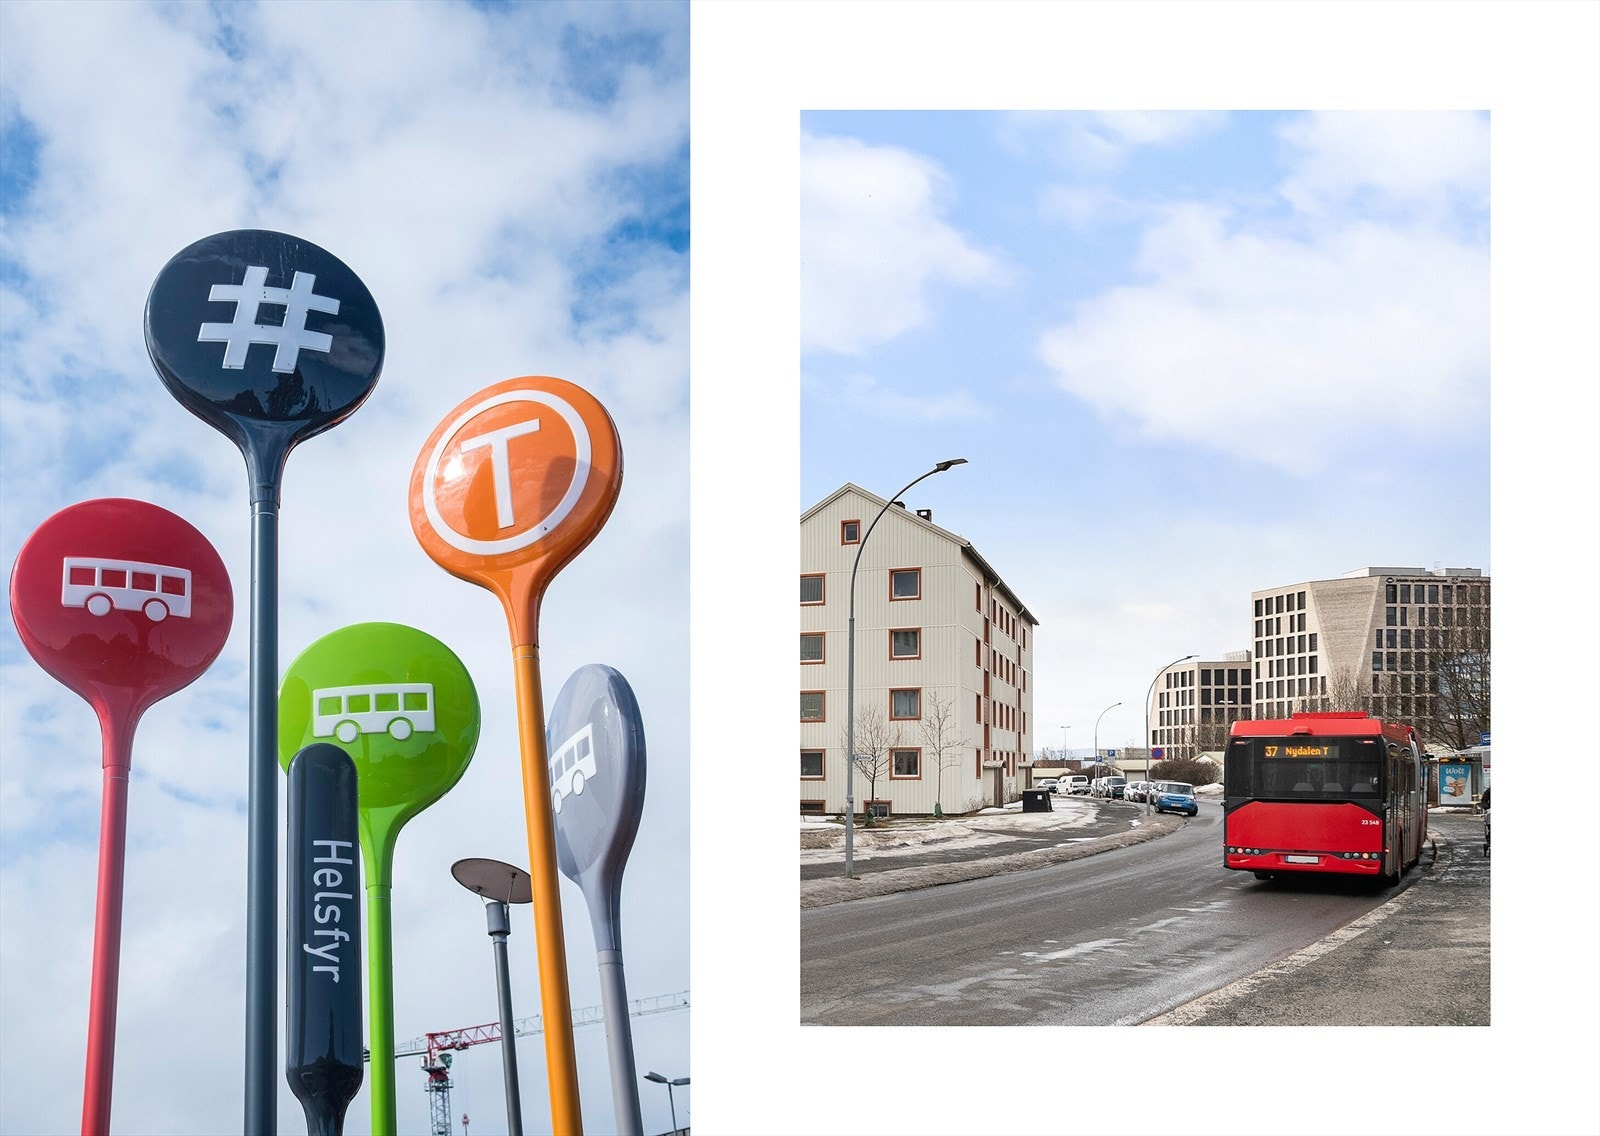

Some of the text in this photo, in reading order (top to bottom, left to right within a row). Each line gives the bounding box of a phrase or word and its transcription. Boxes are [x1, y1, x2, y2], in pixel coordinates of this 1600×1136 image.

[460, 418, 540, 529] T
[1265, 746, 1329, 757] 37 Nydalen T
[1445, 767, 1465, 775] Wolt
[303, 840, 353, 984] Helsfyr
